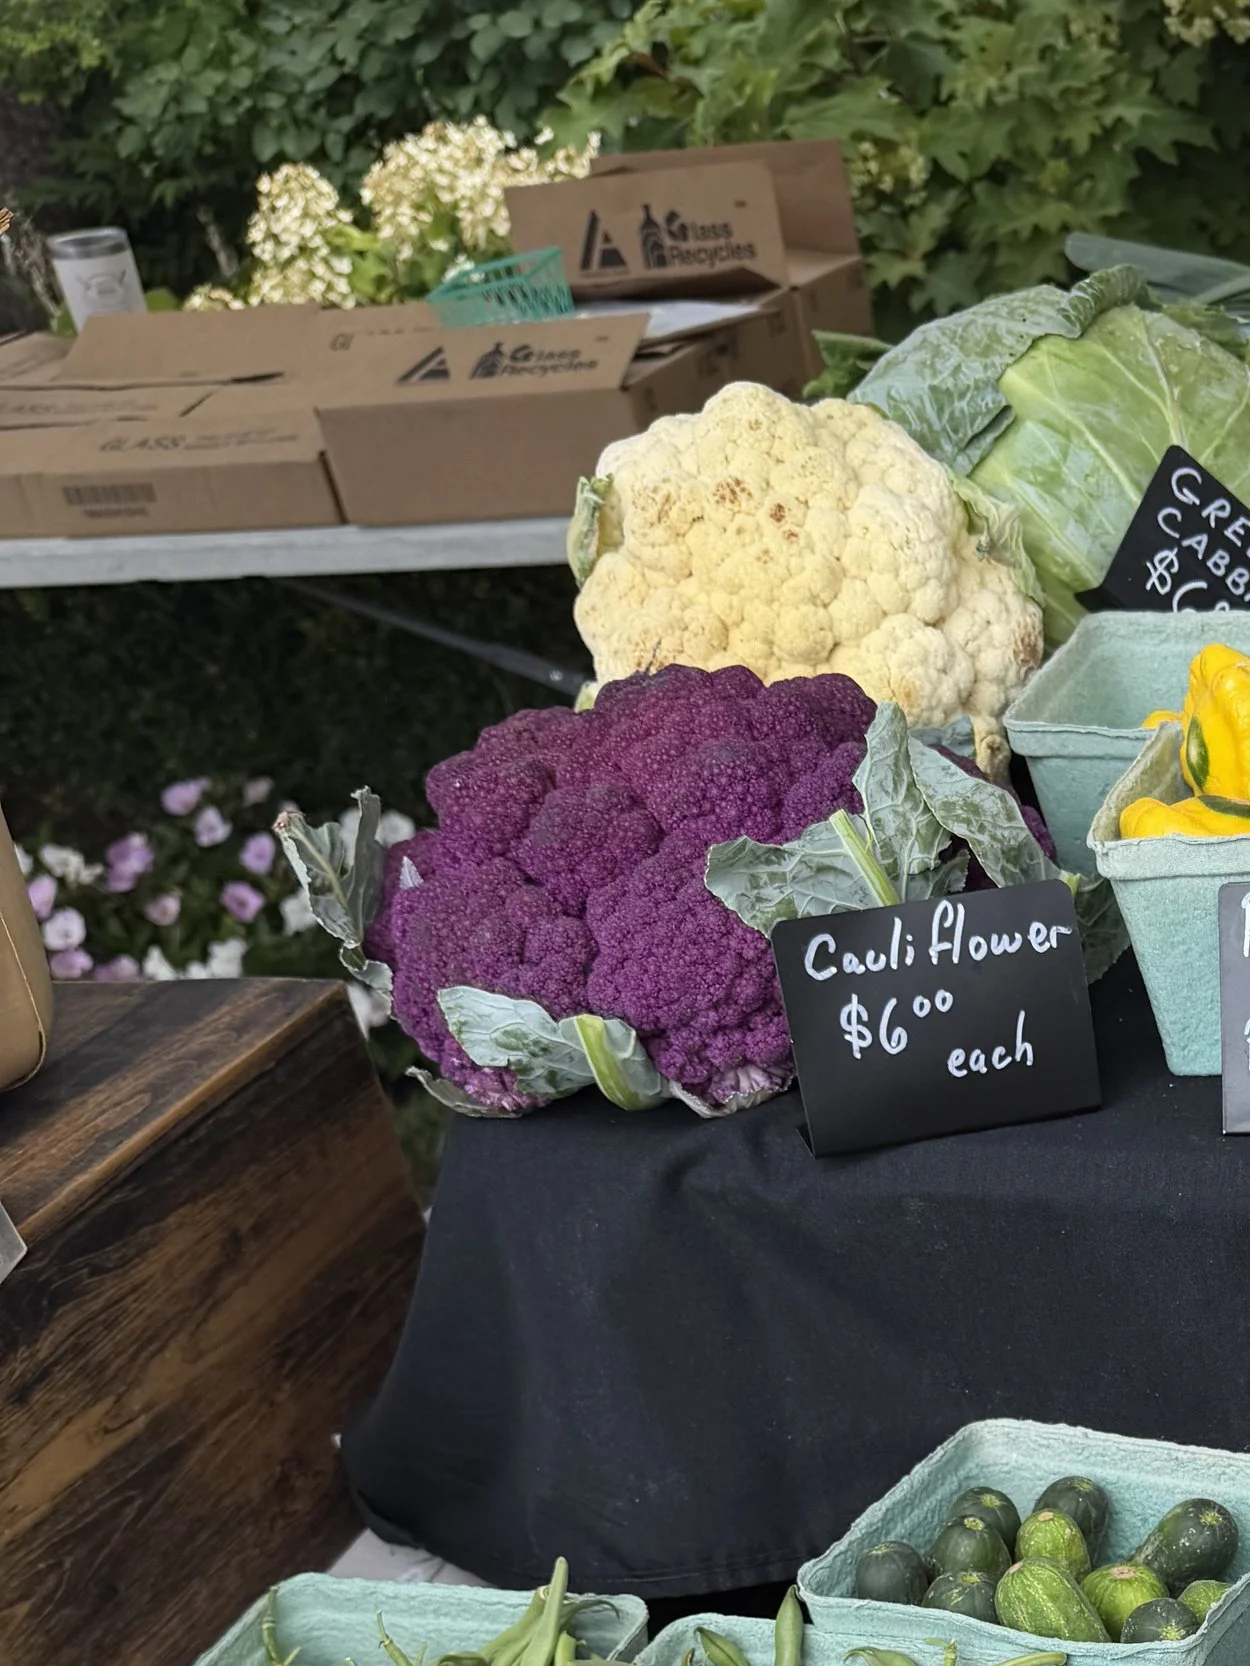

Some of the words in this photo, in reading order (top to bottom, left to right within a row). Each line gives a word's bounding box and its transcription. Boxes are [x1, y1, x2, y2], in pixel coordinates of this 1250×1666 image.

[664, 209, 734, 242] Glass
[669, 242, 757, 269] Recycles
[947, 1010, 1034, 1078] each
